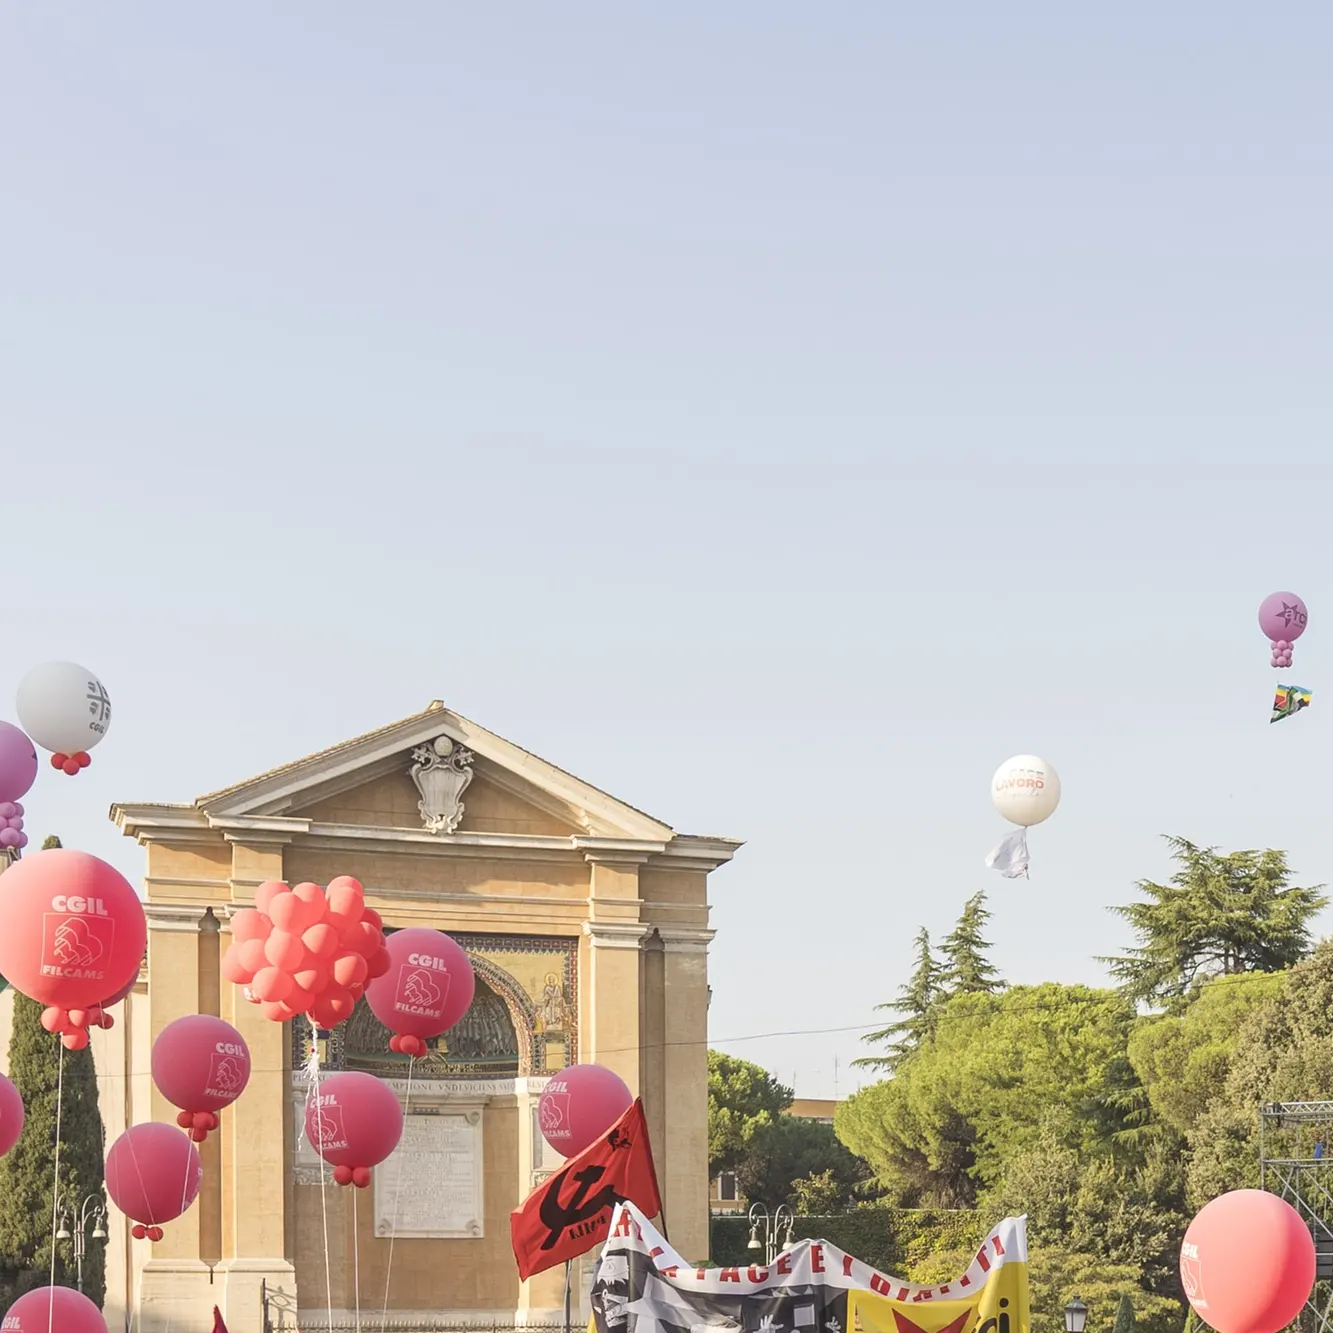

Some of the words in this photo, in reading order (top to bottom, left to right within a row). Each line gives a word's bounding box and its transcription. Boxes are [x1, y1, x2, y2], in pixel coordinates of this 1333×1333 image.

[996, 778, 1044, 791] LAVORO
[51, 895, 108, 916] CGIL
[407, 952, 447, 972] CGIL
[42, 964, 106, 980] FILCAMS
[396, 1002, 442, 1018] FILCAMS
[215, 1042, 245, 1057] CGIL
